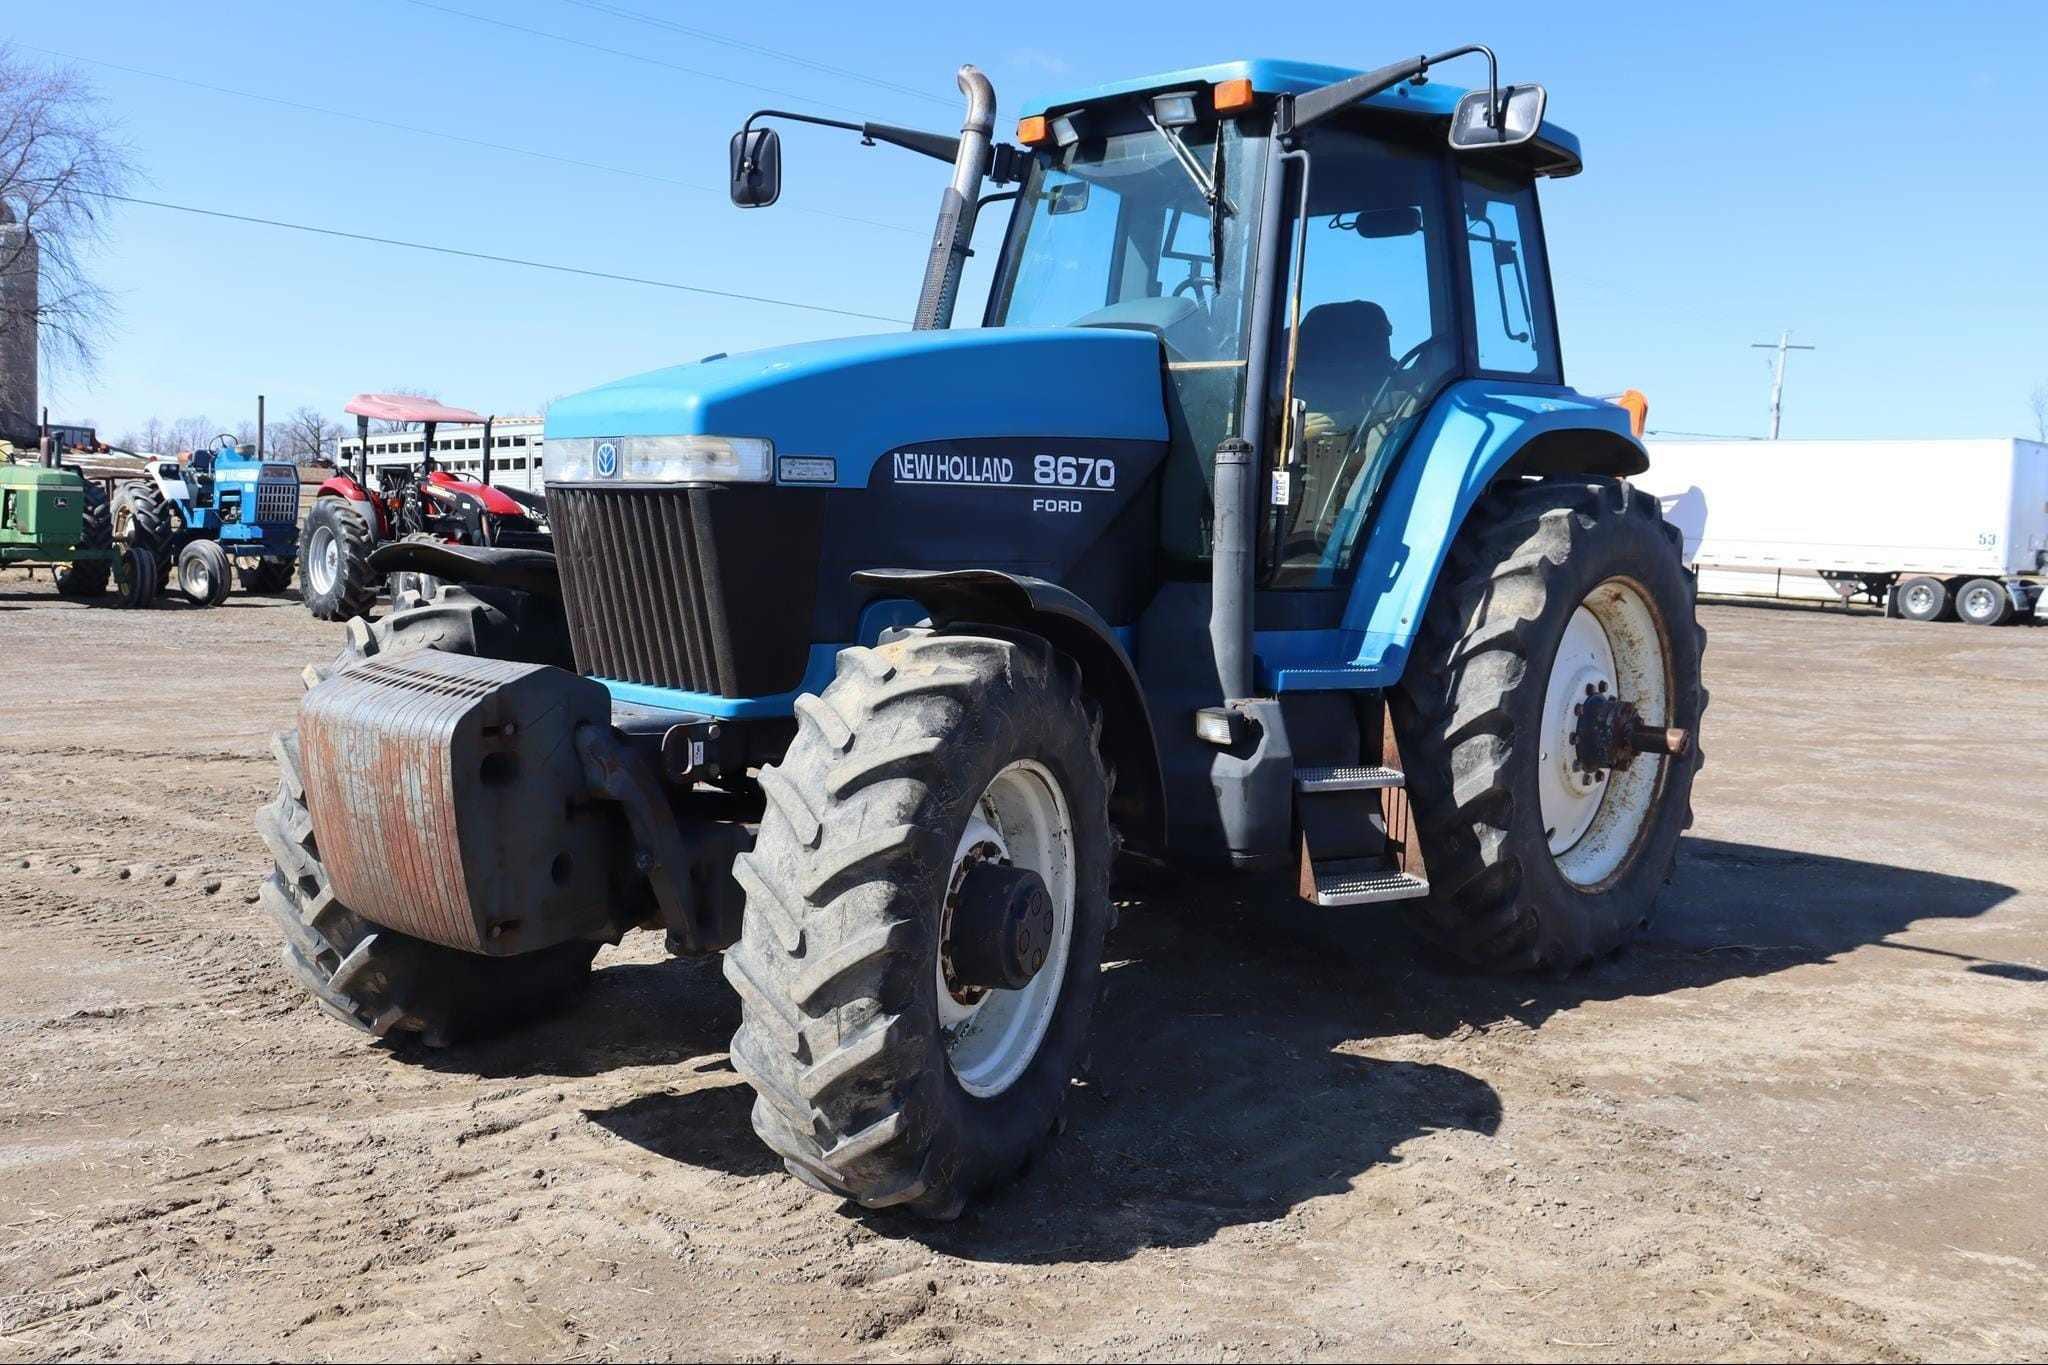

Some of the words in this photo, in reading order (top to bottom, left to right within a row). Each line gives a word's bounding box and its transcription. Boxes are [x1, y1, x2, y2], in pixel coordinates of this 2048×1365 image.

[893, 453, 933, 480] NEW
[937, 455, 1013, 482] HOLLAND
[1034, 454, 1115, 487] 8670
[1275, 479, 1287, 502] 3878
[1033, 499, 1082, 513] FORD
